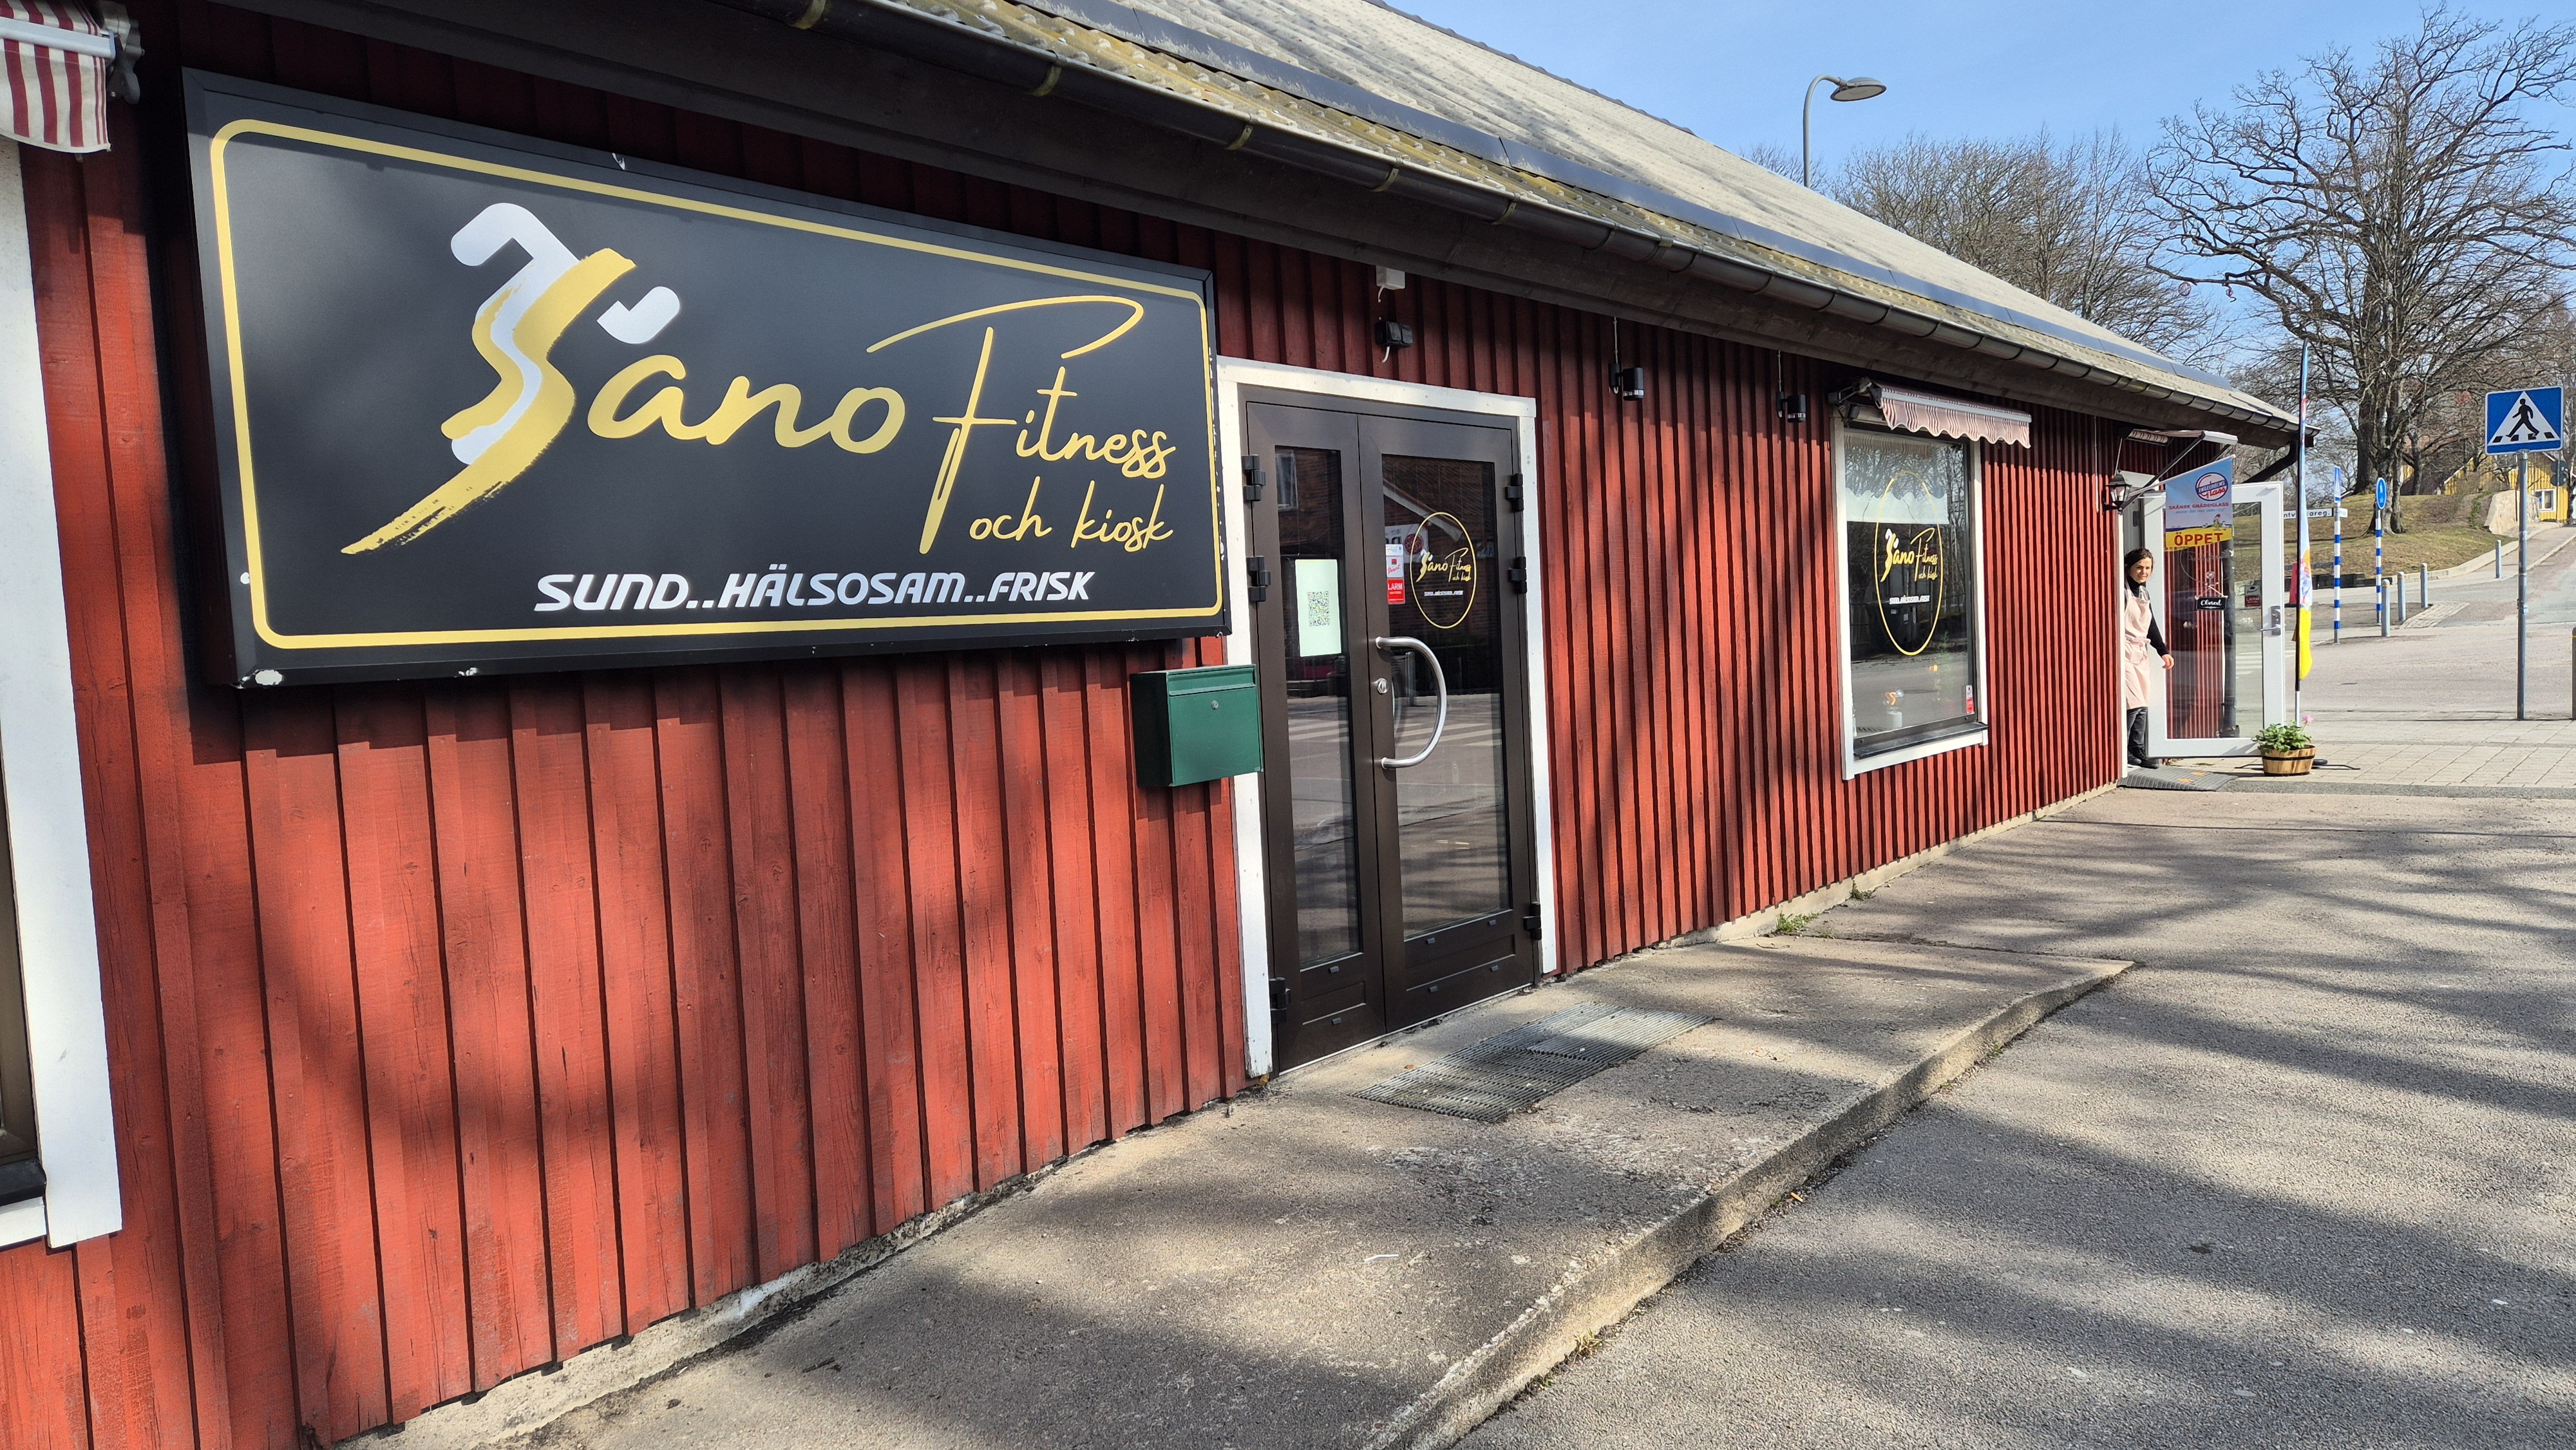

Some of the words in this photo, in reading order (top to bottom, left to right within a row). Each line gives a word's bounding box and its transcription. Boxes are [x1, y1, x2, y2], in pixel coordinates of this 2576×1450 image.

[866, 296, 1176, 554] Fitness
[969, 476, 1052, 541] och
[1071, 480, 1173, 552] kiosk
[2174, 532, 2223, 546] ÖPPET
